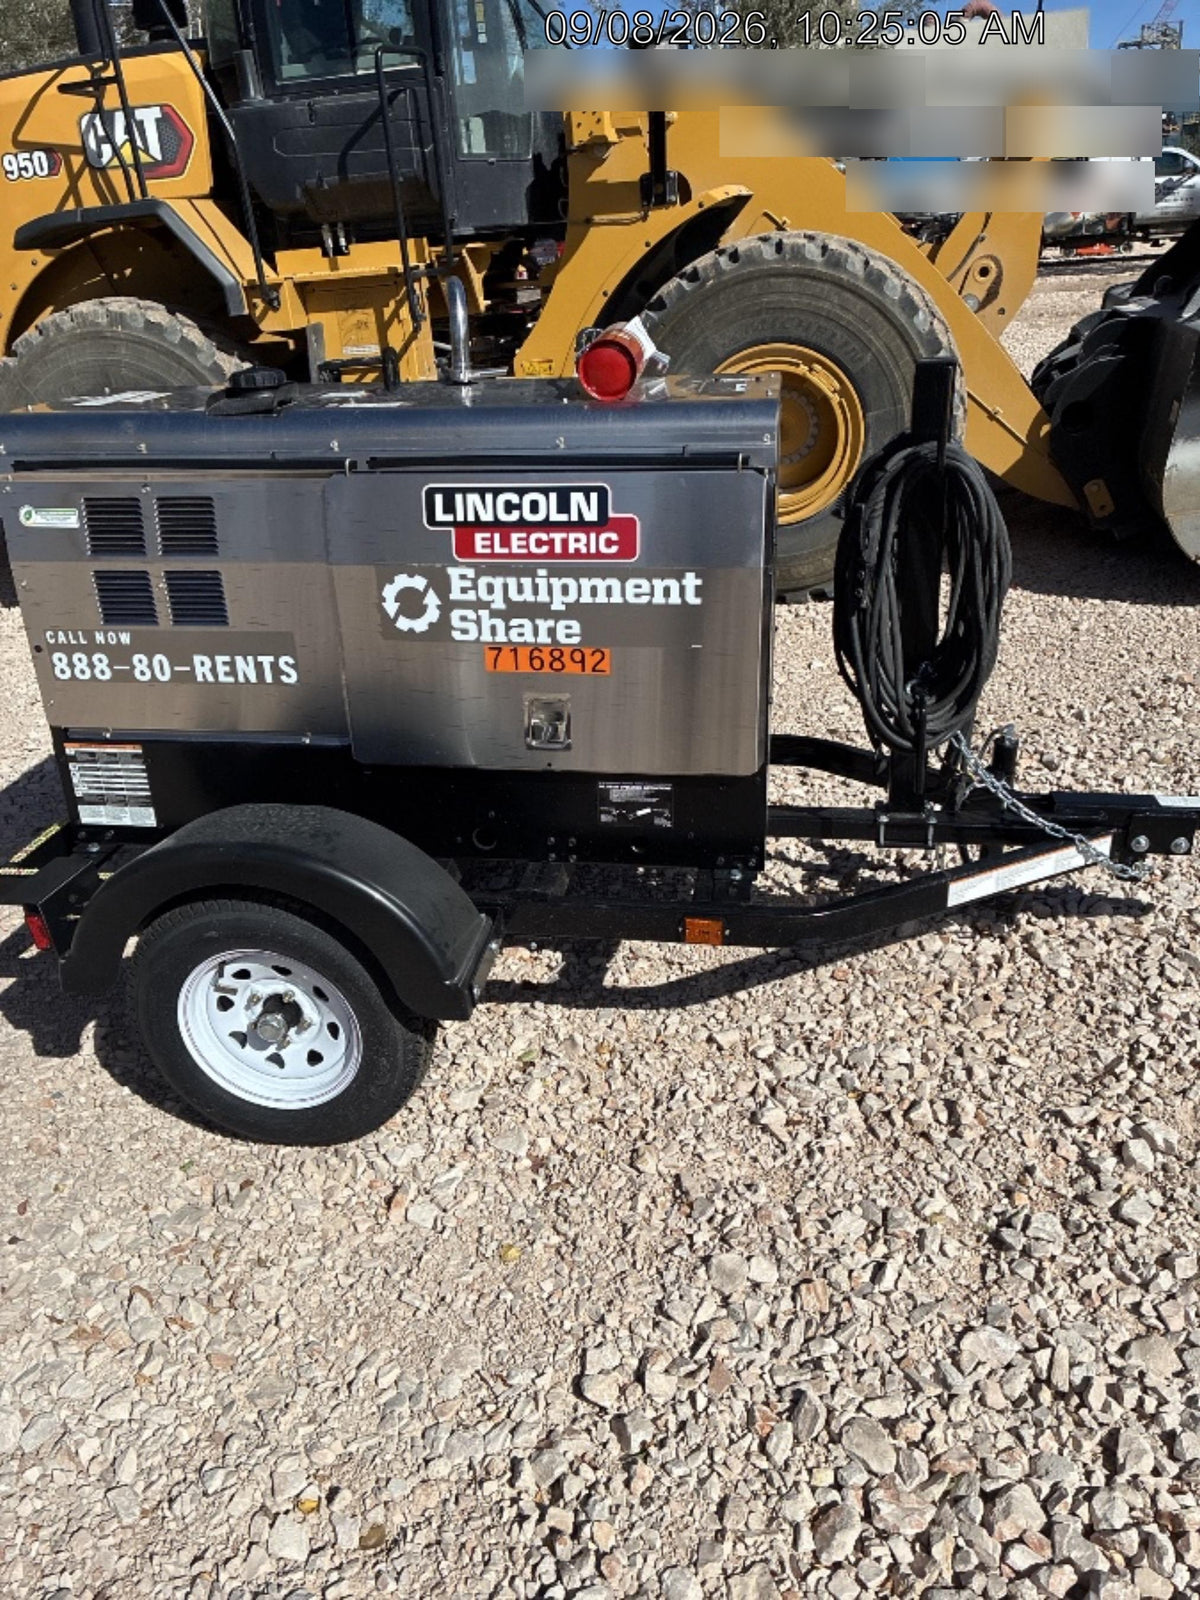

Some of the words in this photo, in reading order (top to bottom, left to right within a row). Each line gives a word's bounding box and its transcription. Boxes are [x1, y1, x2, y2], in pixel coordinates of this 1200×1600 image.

[81, 106, 163, 168] CAT
[2, 151, 49, 181] 950
[433, 491, 600, 522] LINCOLN
[474, 532, 620, 555] ELECTRIC
[446, 566, 704, 611] Equipment
[45, 630, 88, 645] CALL
[95, 631, 131, 646] NOW
[450, 608, 582, 644] Share
[51, 652, 299, 685] 888-80-RENTS
[487, 646, 608, 674] 716892
